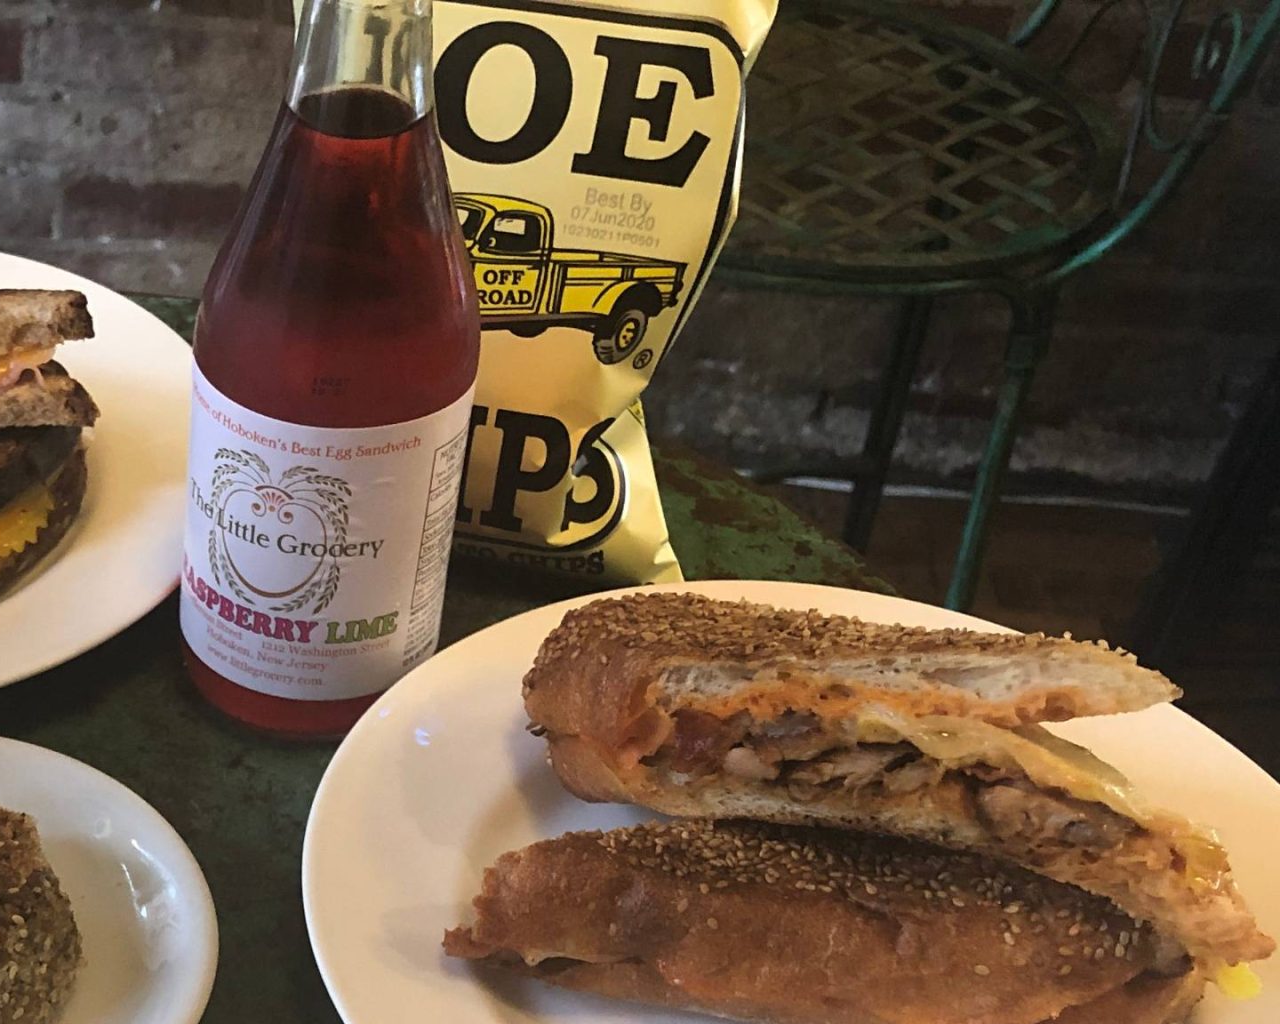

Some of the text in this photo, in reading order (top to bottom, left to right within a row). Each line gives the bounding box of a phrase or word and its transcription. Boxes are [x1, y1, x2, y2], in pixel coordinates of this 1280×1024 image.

[433, 20, 715, 188] OE
[584, 187, 654, 219] Best By
[482, 270, 525, 286] OFF
[479, 290, 533, 306] ROAD
[223, 414, 289, 450] Hoboken's
[291, 441, 322, 457] Best
[325, 445, 354, 461] Egg
[355, 436, 422, 458] Sandwich
[455, 404, 617, 532] IPS
[190, 477, 385, 560] The Little Grocery
[324, 612, 400, 645] LIME
[257, 650, 281, 667] New
[282, 658, 329, 674] Jersey
[287, 641, 358, 659] Washington
[359, 637, 392, 654] Street
